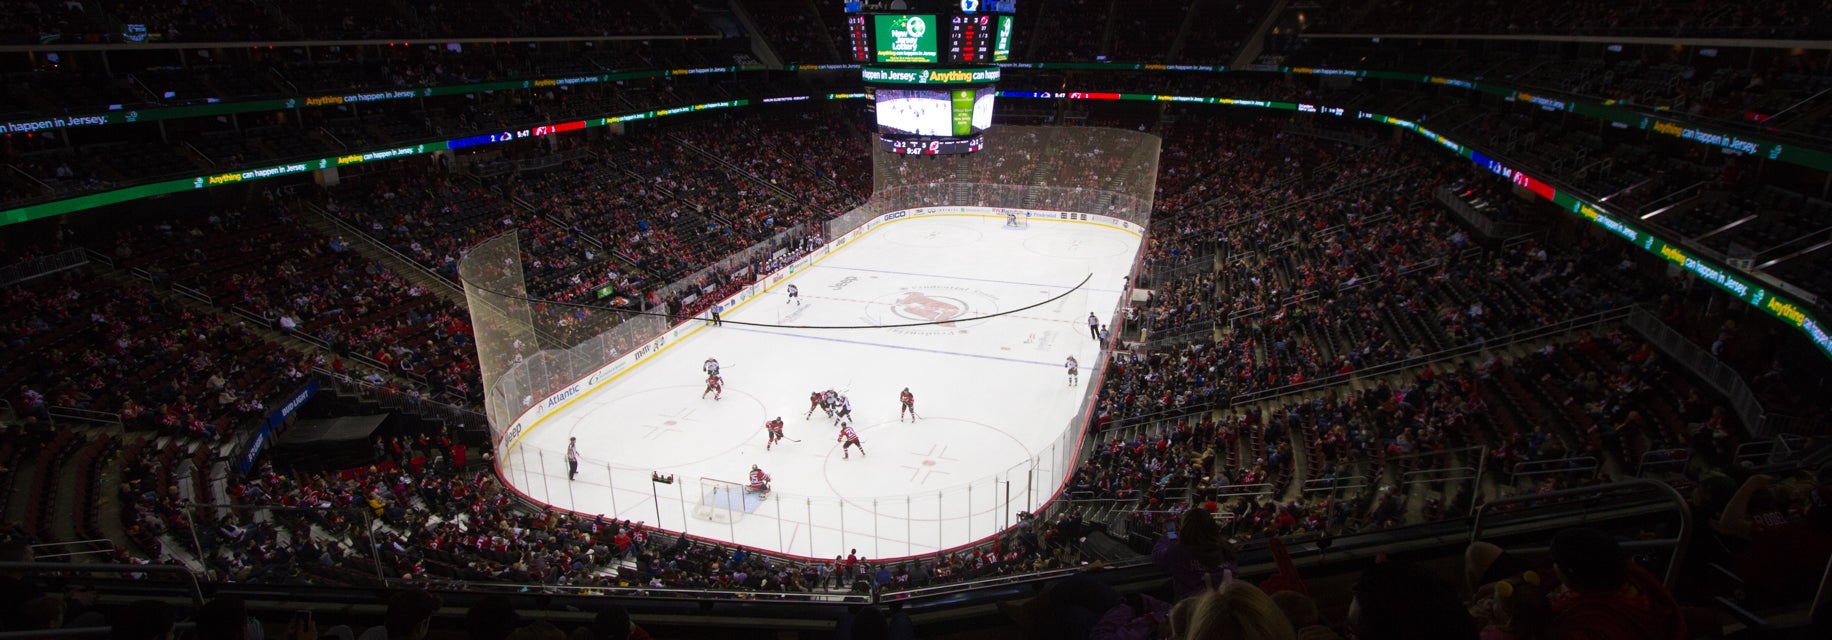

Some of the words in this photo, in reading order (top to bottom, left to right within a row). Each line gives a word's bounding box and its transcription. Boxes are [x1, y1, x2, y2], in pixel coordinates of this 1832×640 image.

[881, 70, 888, 80] in
[930, 70, 972, 83] Anything
[973, 72, 985, 80] can
[305, 95, 343, 106] Anything
[344, 95, 357, 103] can
[358, 92, 386, 102] happen
[8, 119, 53, 132] happen
[54, 117, 65, 128] in
[1654, 120, 1682, 138] Anything
[1682, 128, 1694, 139] can
[1694, 127, 1721, 146] happen
[1721, 134, 1729, 147] in
[338, 154, 364, 164] Anything
[364, 153, 373, 161] can
[373, 149, 392, 159] happen
[208, 172, 241, 185] Anything
[242, 170, 254, 179] can
[254, 166, 279, 178] happen
[279, 165, 286, 173] in
[884, 210, 906, 221] GEICO
[1580, 204, 1598, 222] Anything
[1661, 243, 1687, 267] Anything
[1685, 257, 1697, 270] can
[1696, 259, 1720, 281] happen
[1767, 296, 1806, 328] Anything
[281, 404, 294, 417] BUD
[293, 389, 309, 407] LIGHT
[548, 384, 581, 408] Atlantic
[505, 423, 522, 447] Jeep
